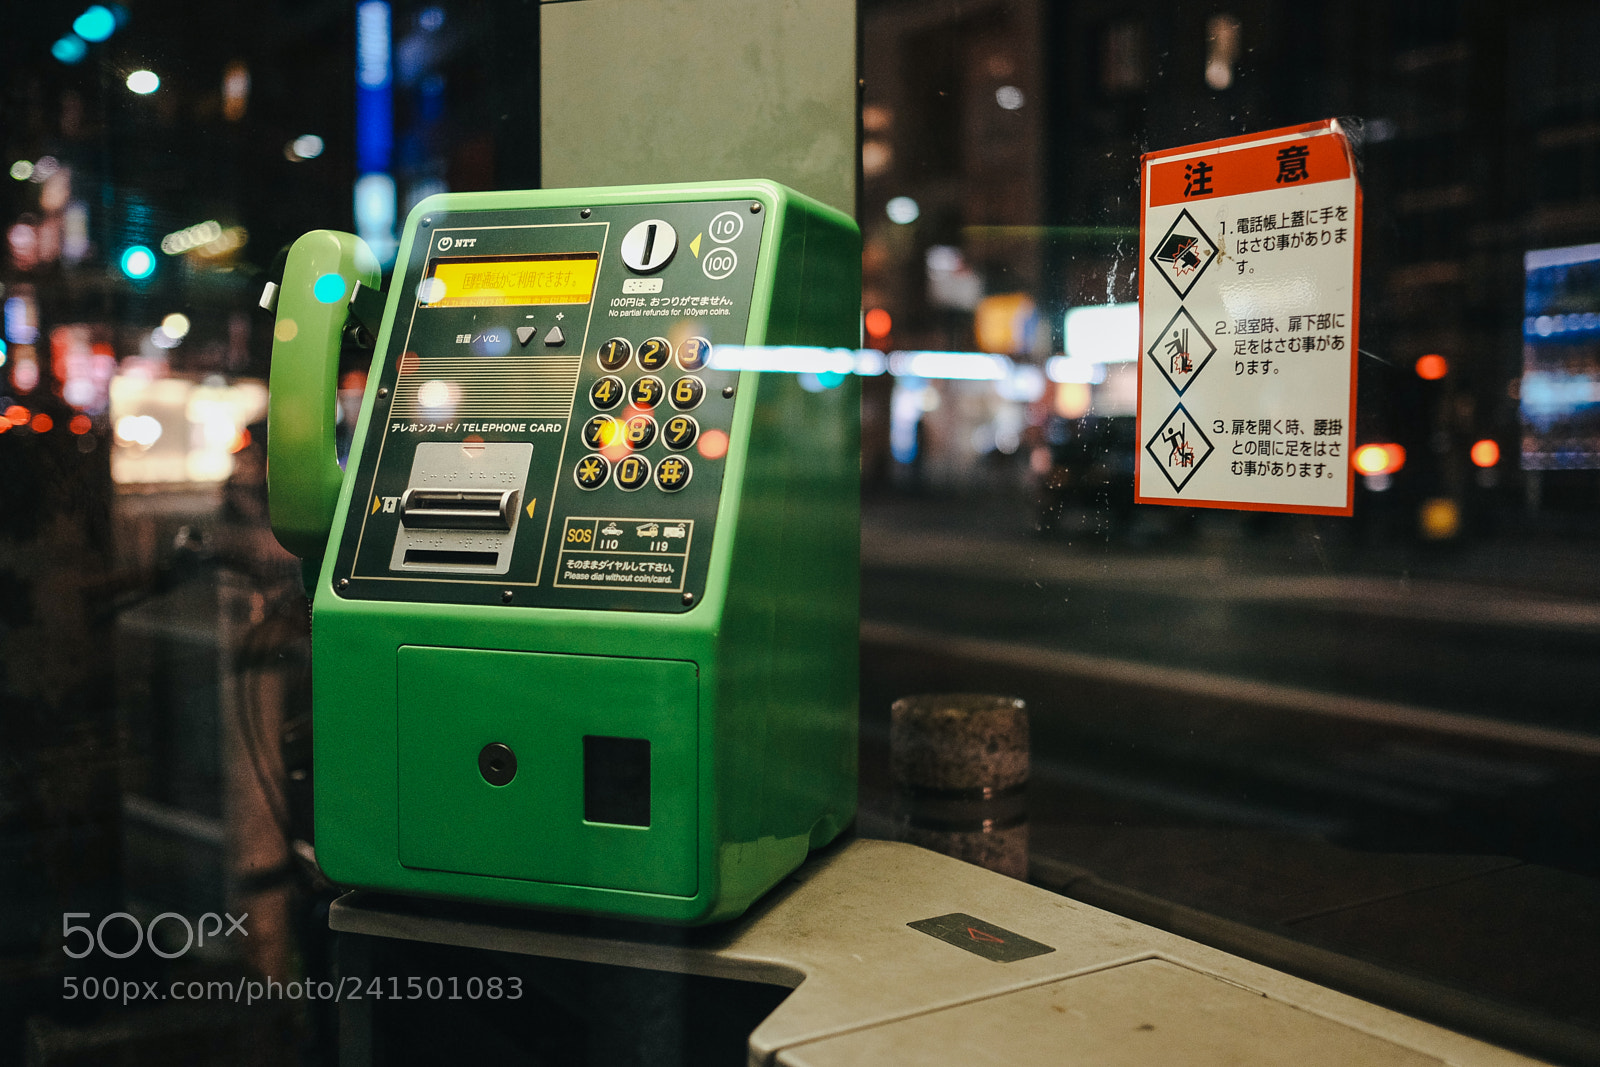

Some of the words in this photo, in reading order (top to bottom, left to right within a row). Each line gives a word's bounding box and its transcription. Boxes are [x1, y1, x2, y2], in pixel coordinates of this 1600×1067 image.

[715, 219, 735, 236] 10
[454, 238, 477, 248] NTT
[1236, 228, 1348, 254] はさむ事がありま
[708, 256, 732, 272] 100
[1236, 258, 1255, 275] す。
[608, 309, 619, 317] No
[620, 308, 642, 318] partial
[642, 307, 670, 317] refunds
[671, 307, 682, 316] for
[683, 307, 709, 317] 100yen
[709, 307, 731, 316] coins.
[608, 341, 617, 363] 1
[644, 341, 660, 363] 2
[682, 339, 700, 362] 3
[1233, 335, 1346, 356] 足をはさむ事があ
[1234, 360, 1280, 376] ります。
[595, 380, 611, 402] 4
[637, 380, 654, 402] 5
[676, 379, 694, 402] 6
[391, 423, 454, 433] テレホンカード
[462, 423, 526, 433] TELEPHONE
[529, 423, 562, 433] CARD
[592, 420, 608, 442] 7
[628, 418, 647, 442] 8
[670, 418, 688, 442] 9
[1231, 440, 1342, 458] との間に足をはさ
[621, 459, 639, 483] 0
[1230, 460, 1333, 479] む事があります。
[566, 528, 592, 543] SOS
[600, 539, 619, 550] 110
[650, 541, 669, 552] 119
[566, 559, 675, 574] そのままダイヤルして下さい。
[564, 571, 590, 580] Please
[590, 572, 605, 581] dial
[605, 573, 633, 582] without
